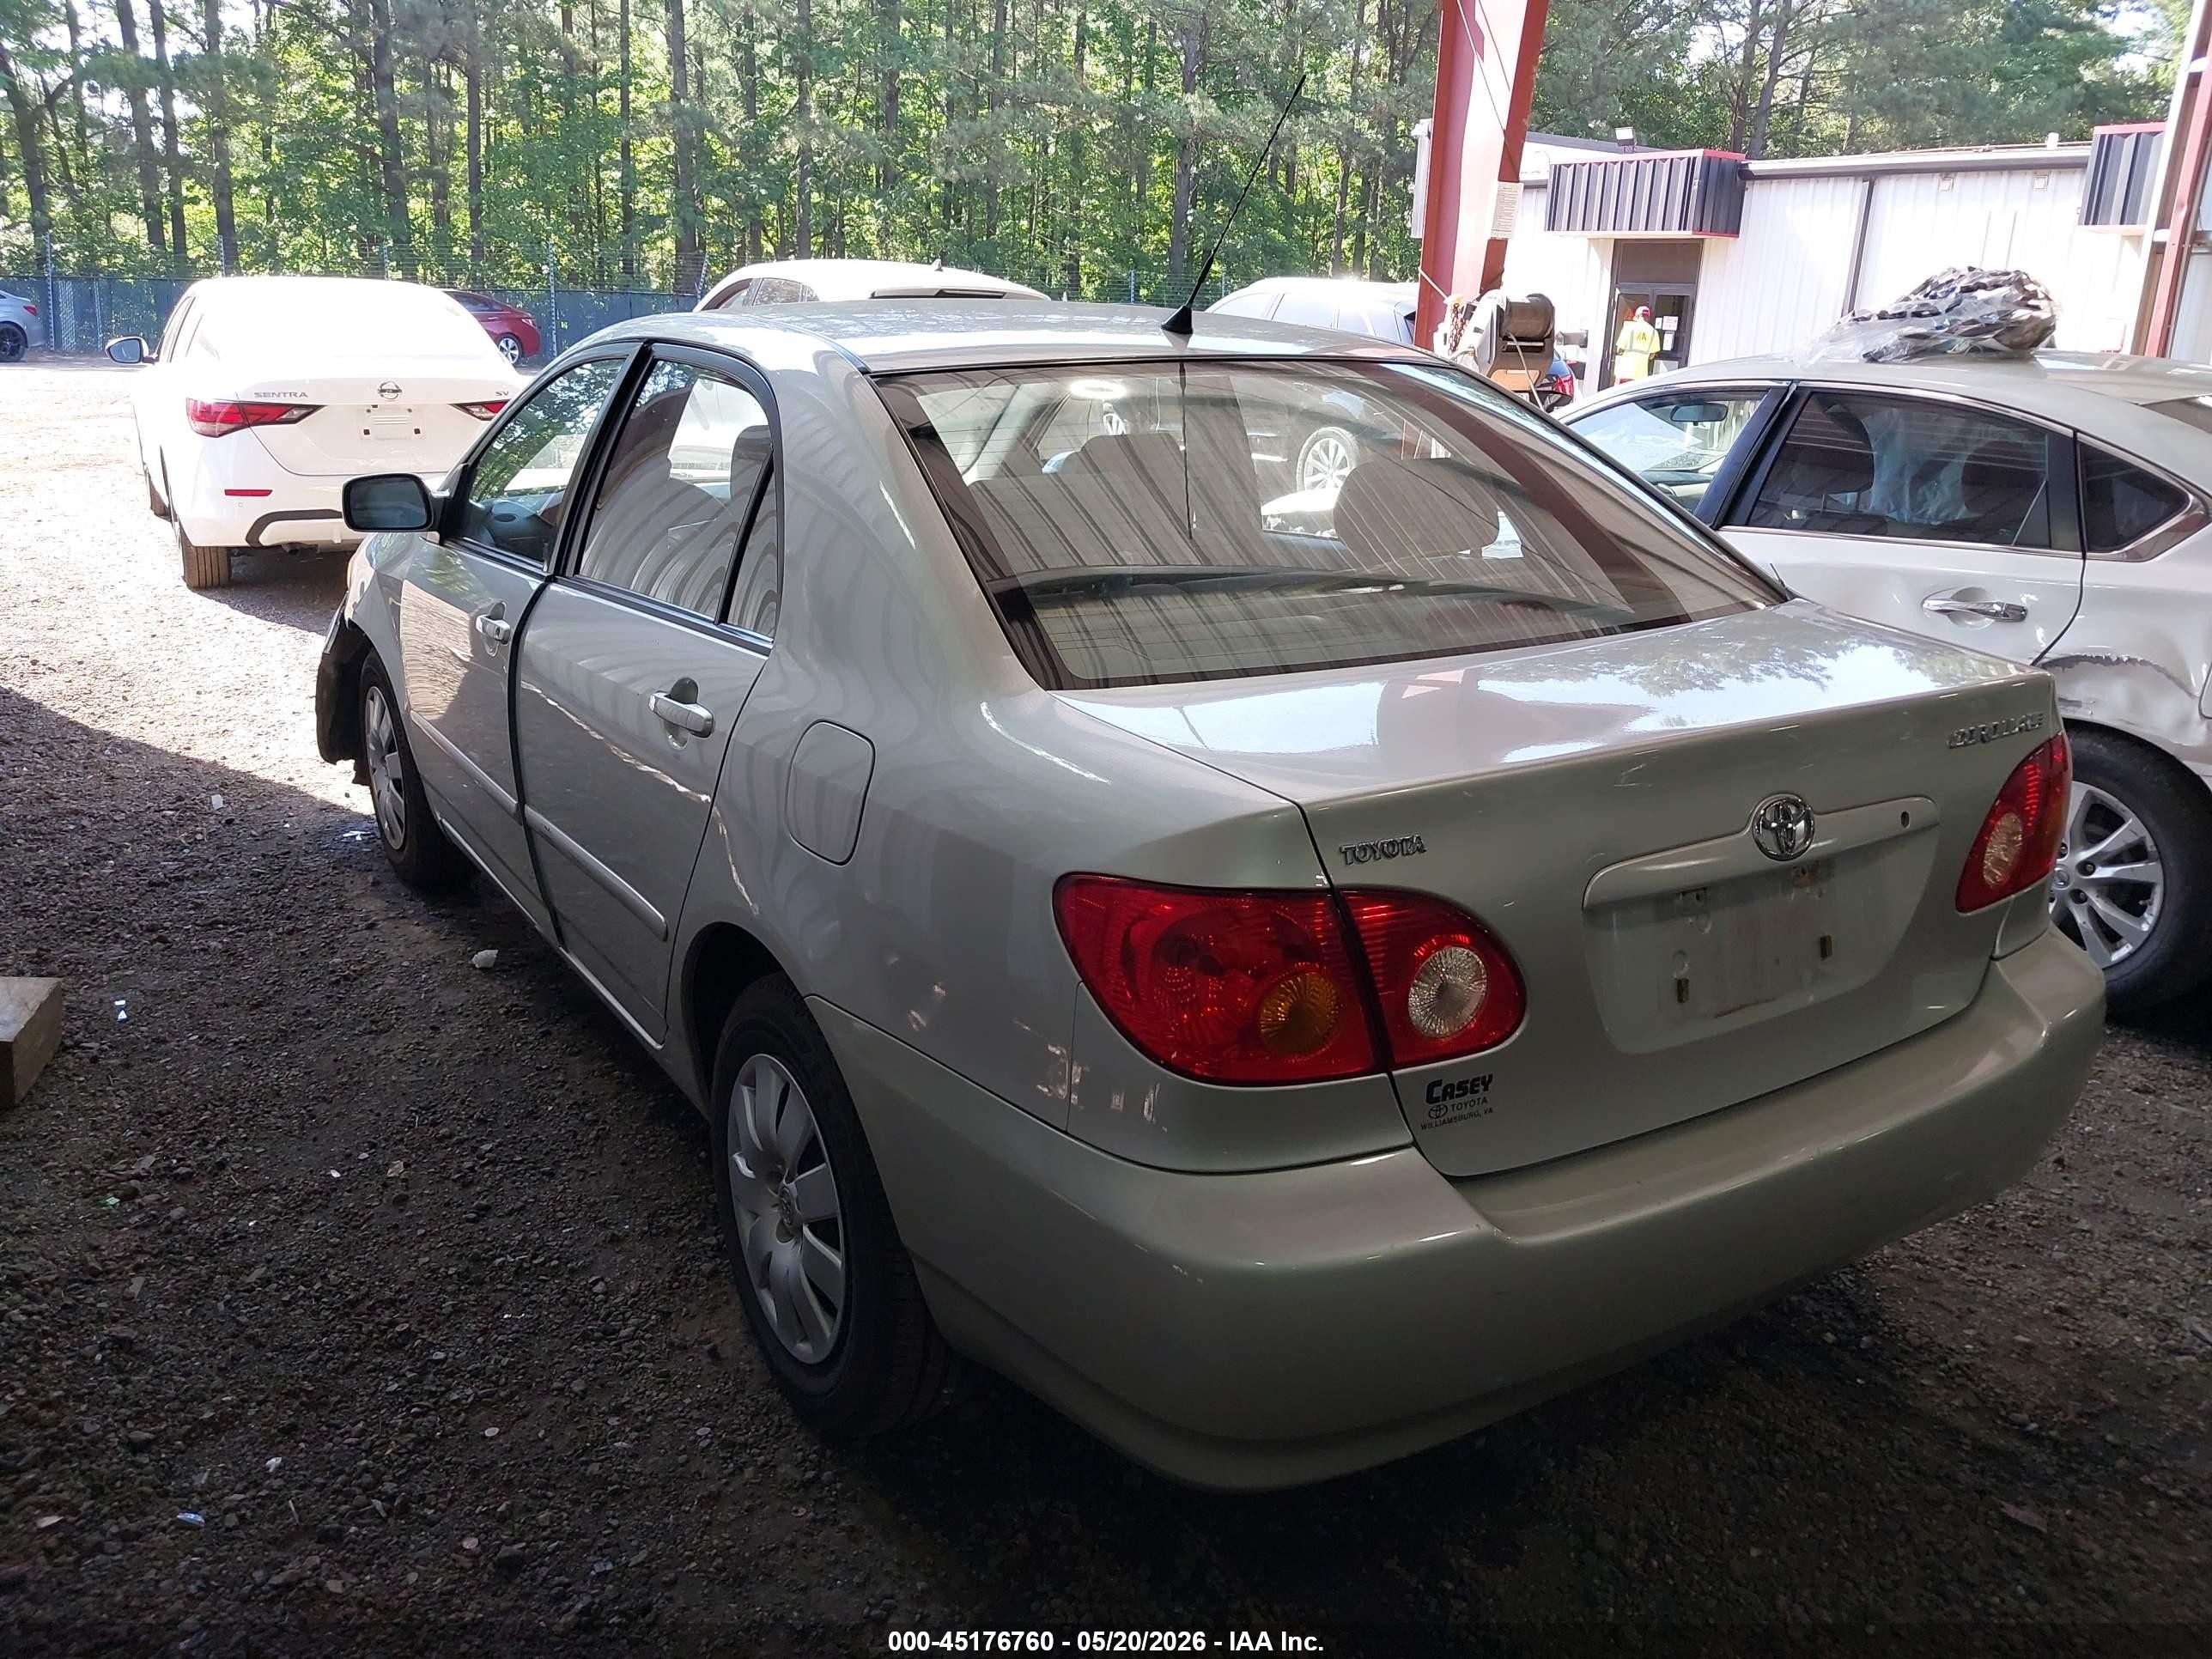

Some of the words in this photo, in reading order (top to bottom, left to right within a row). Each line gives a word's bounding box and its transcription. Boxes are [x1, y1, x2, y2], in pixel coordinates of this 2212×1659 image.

[1339, 834, 1427, 866] TOYOTA
[1425, 1073, 1493, 1105] CASEY
[1450, 1097, 1488, 1113] TOYOTA
[1483, 1106, 1494, 1115] VA
